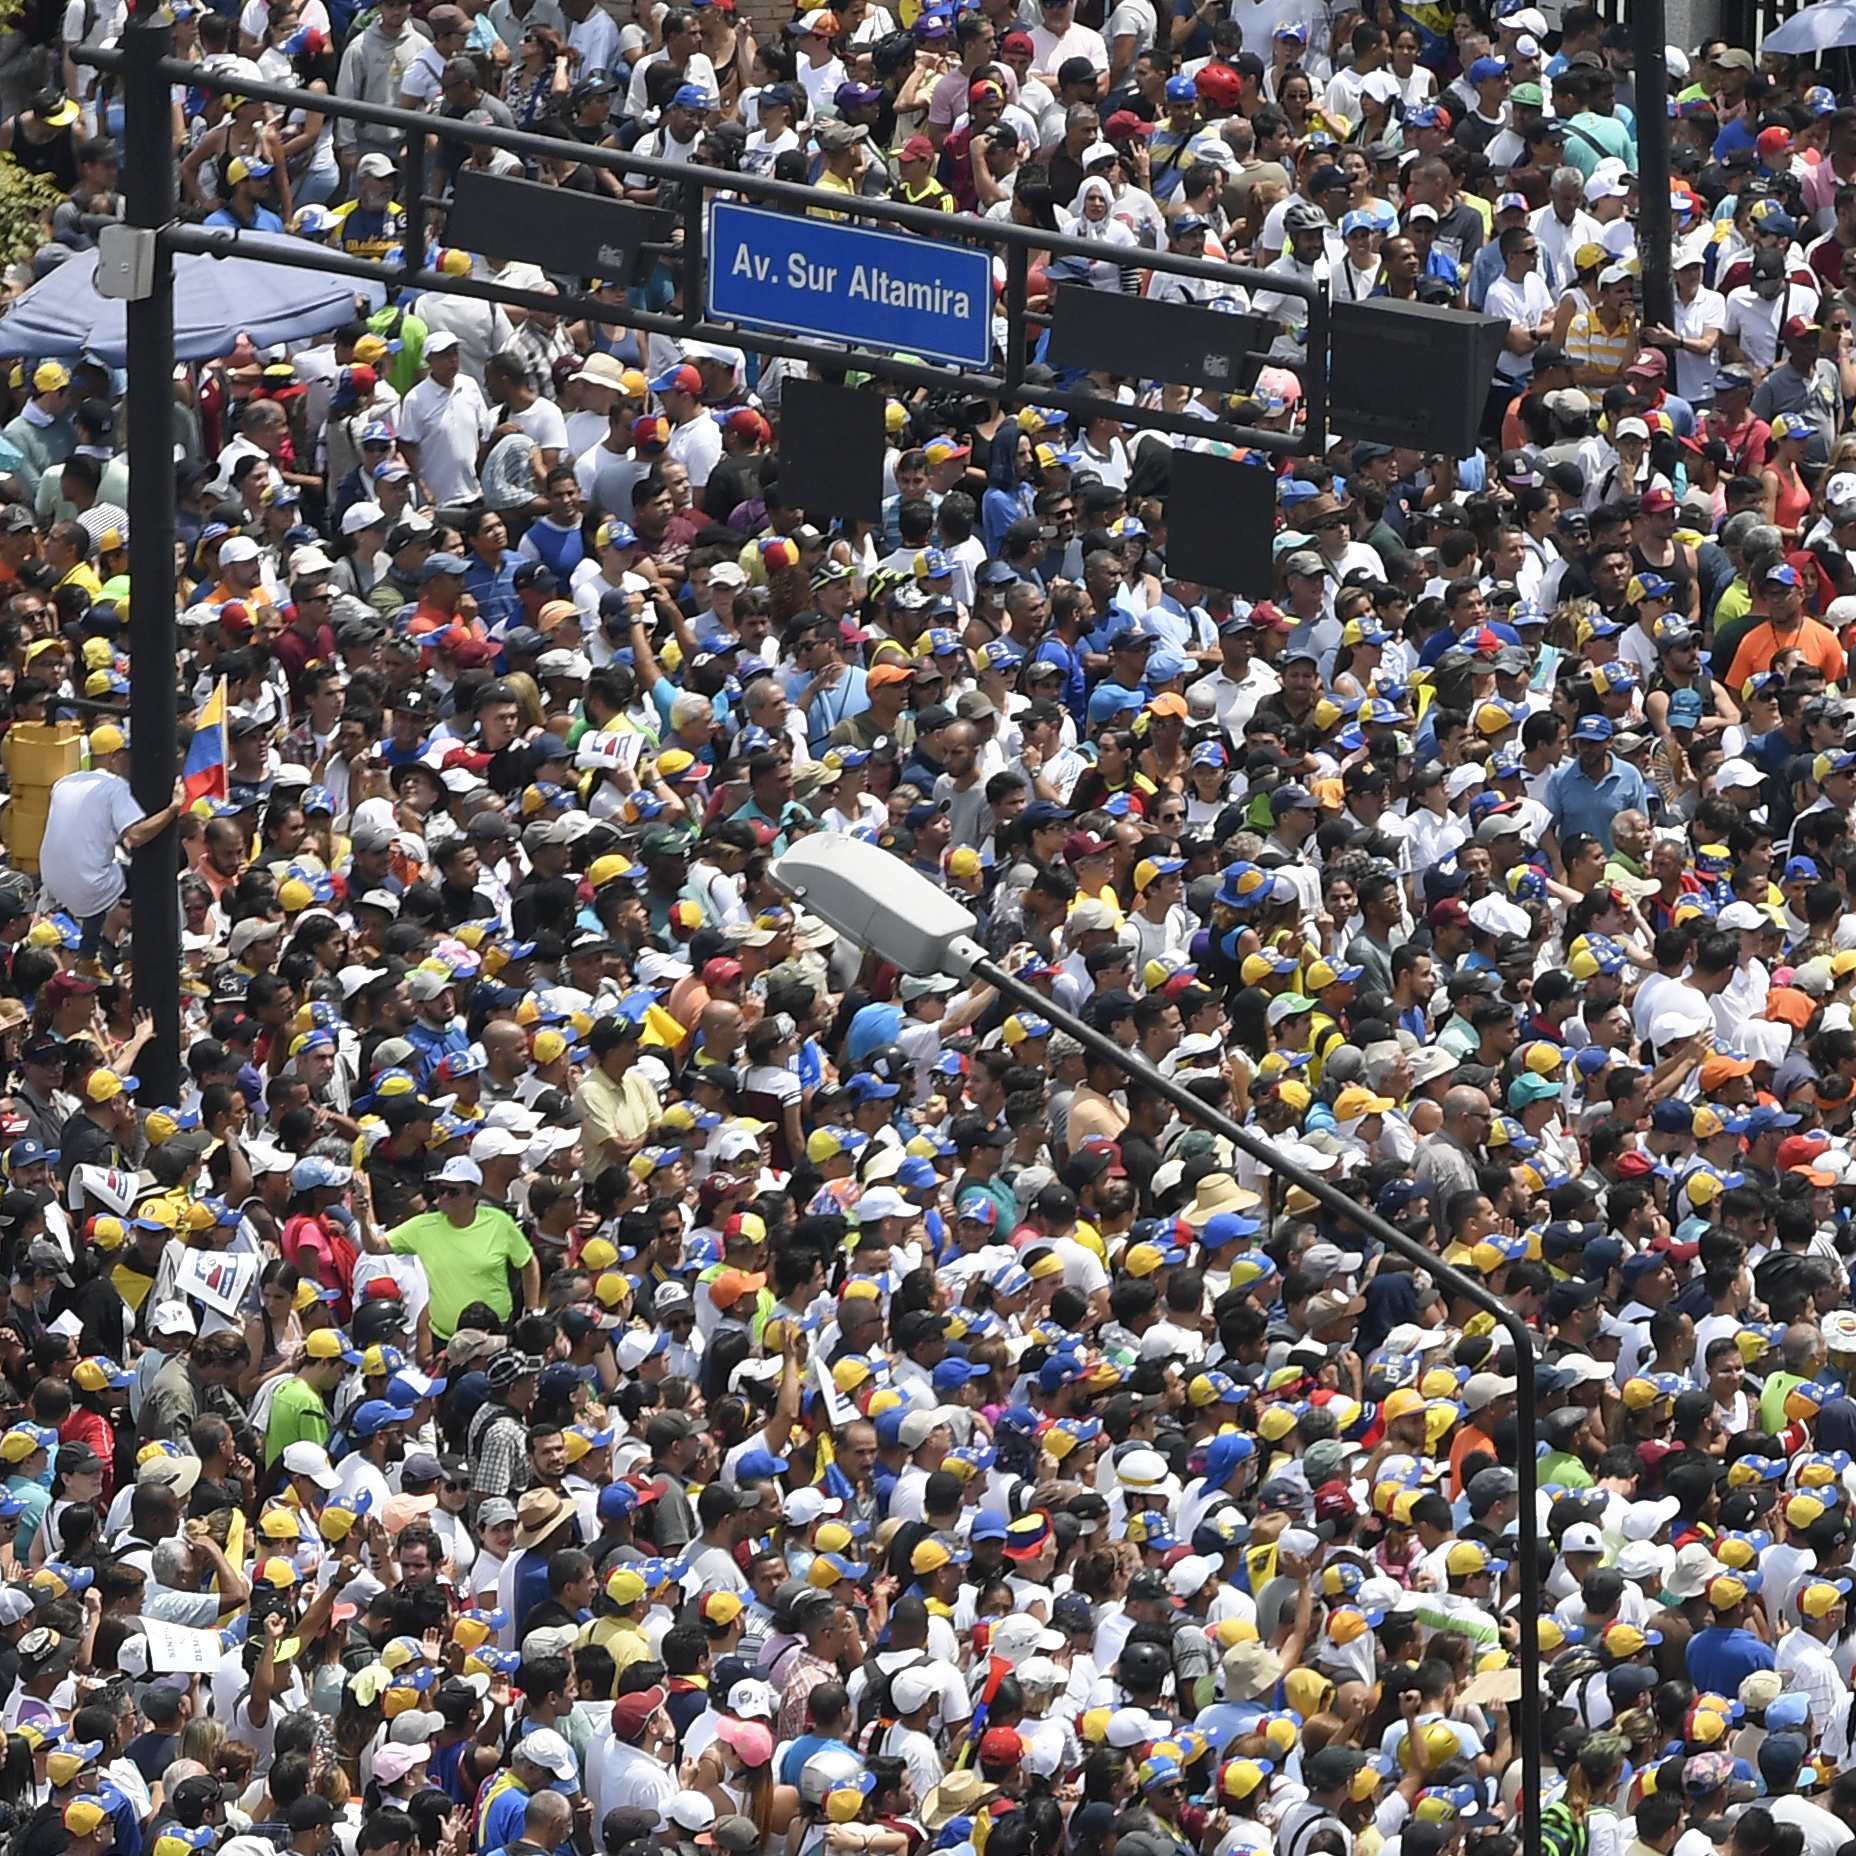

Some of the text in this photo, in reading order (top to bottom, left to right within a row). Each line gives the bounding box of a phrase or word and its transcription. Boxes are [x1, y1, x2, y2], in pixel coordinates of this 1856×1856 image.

[732, 243, 970, 319] Av. Sur Altamira
